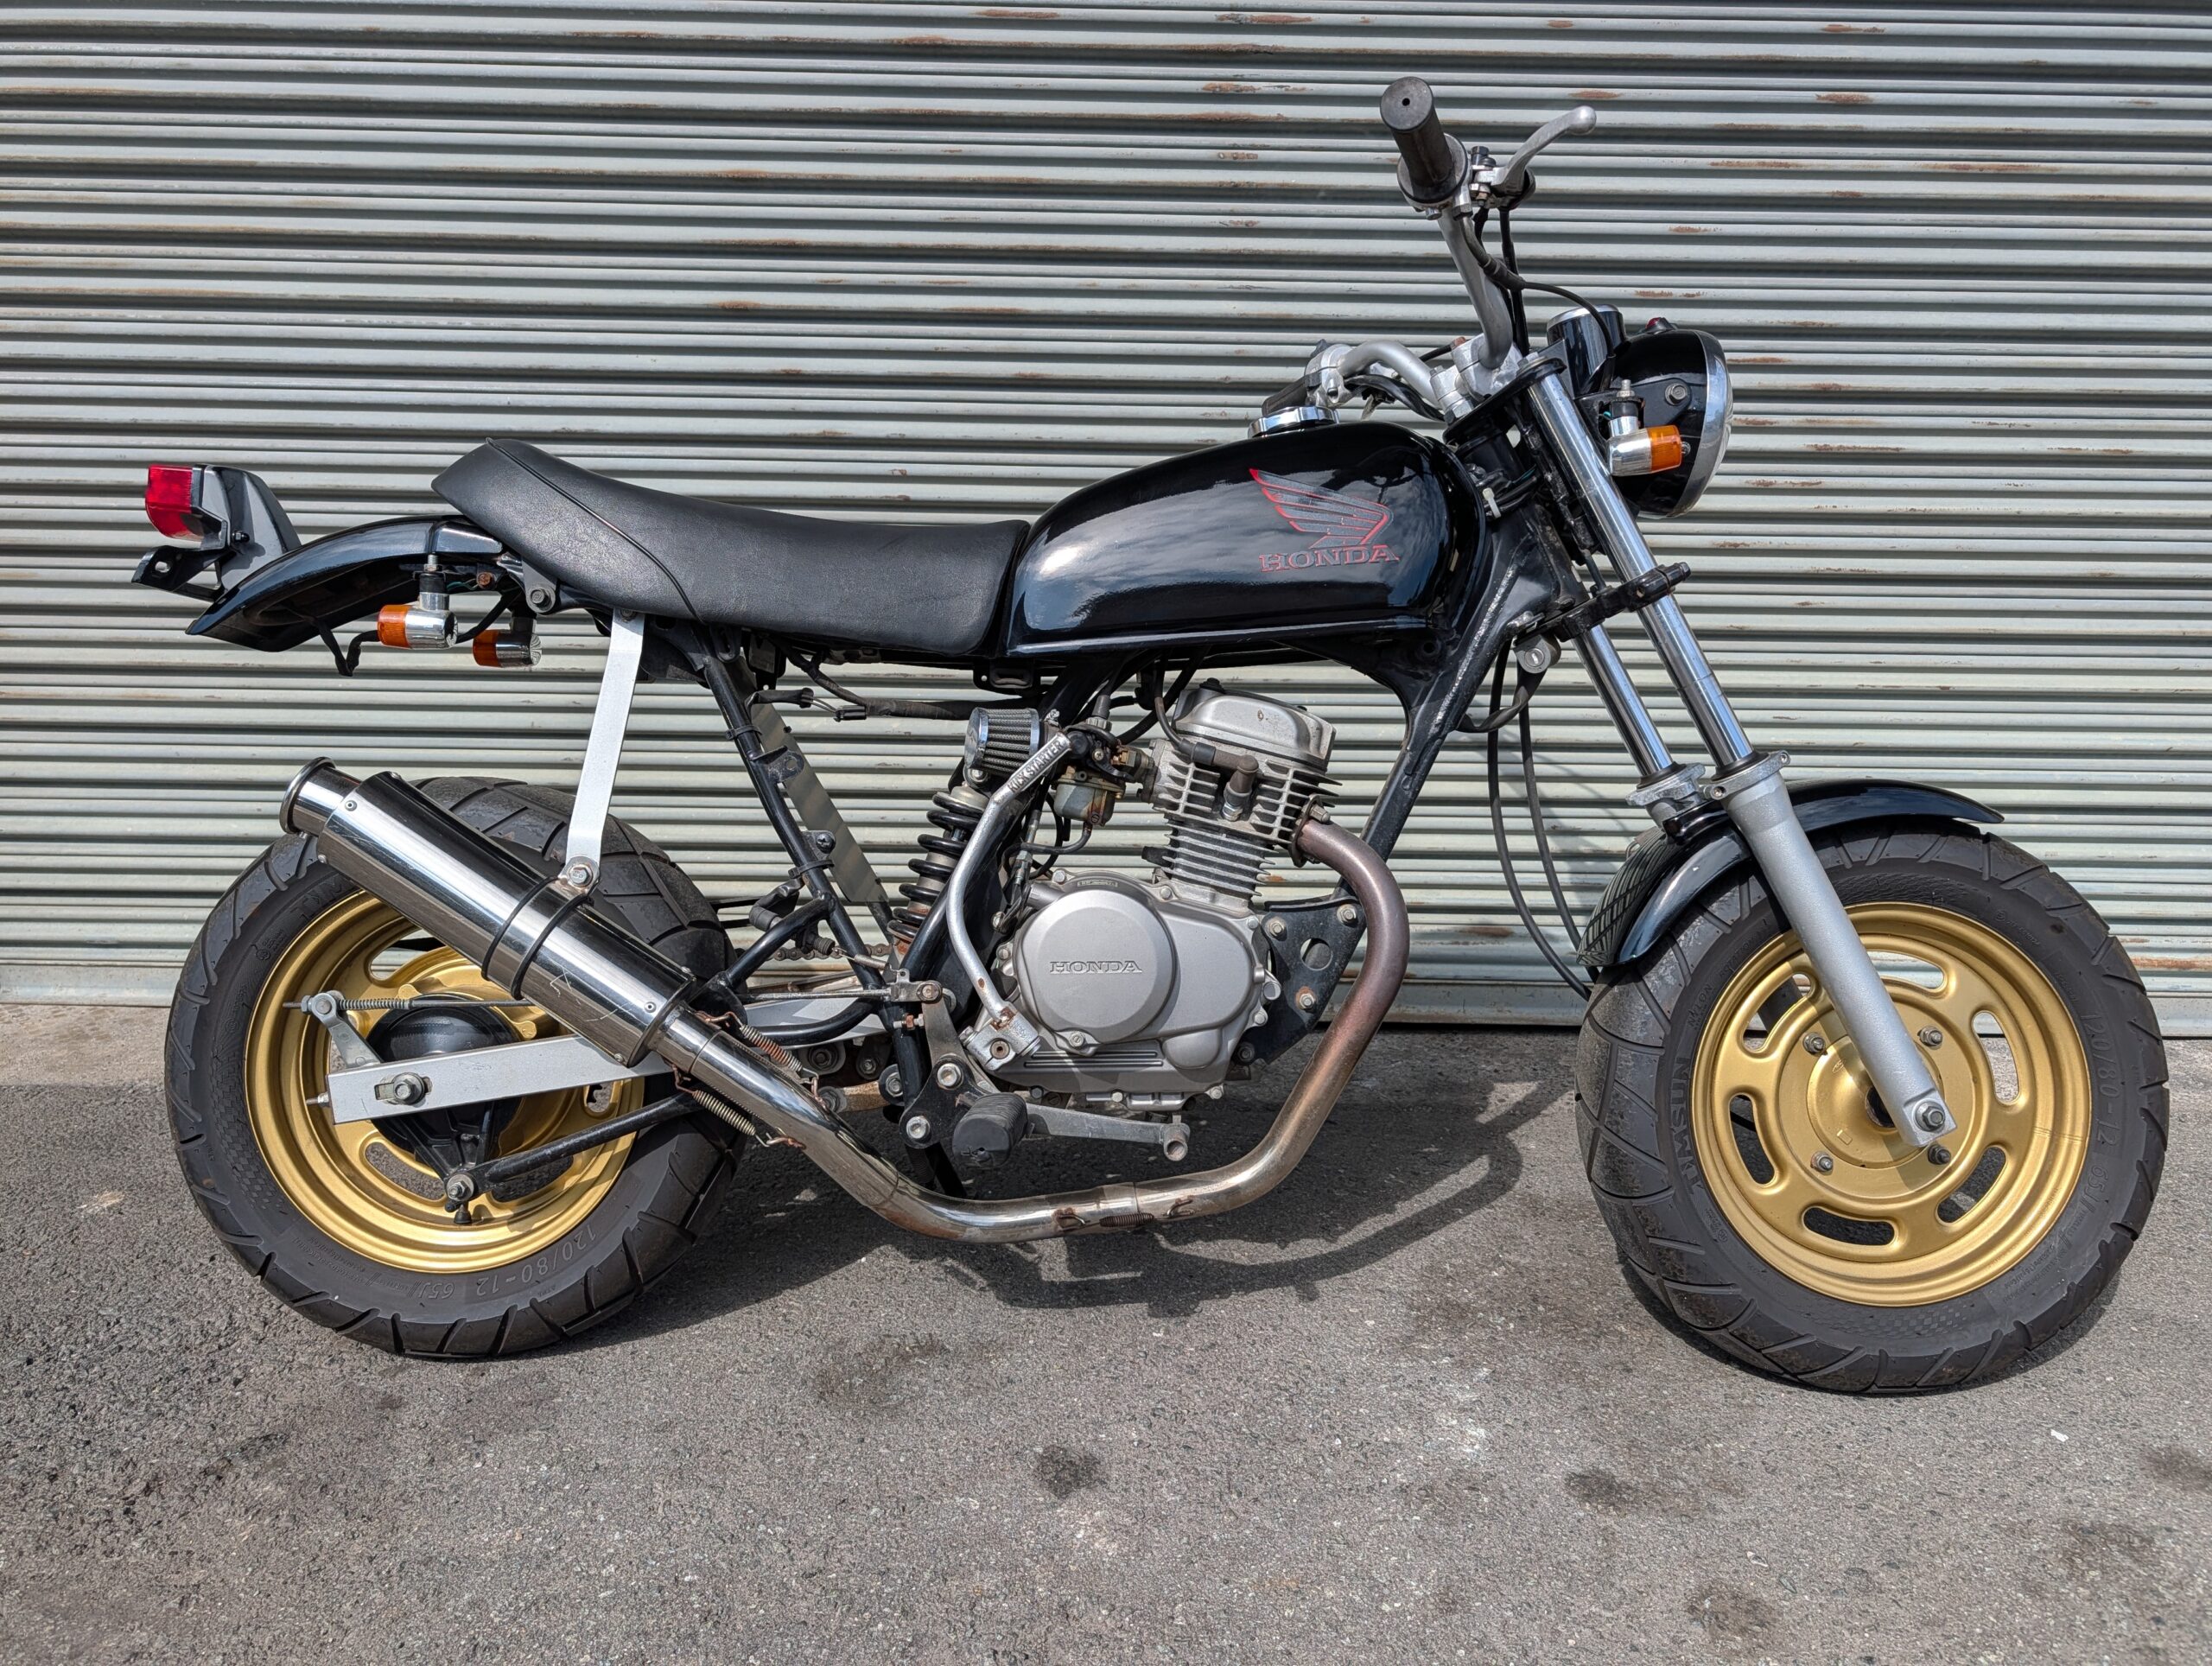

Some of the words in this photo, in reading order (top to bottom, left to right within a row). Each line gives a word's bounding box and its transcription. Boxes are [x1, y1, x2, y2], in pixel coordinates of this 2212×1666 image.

[1259, 544, 1401, 572] HONDA
[1007, 771, 1029, 792] KICK
[1026, 741, 1064, 776] STARTER
[1050, 960, 1142, 974] HONDA
